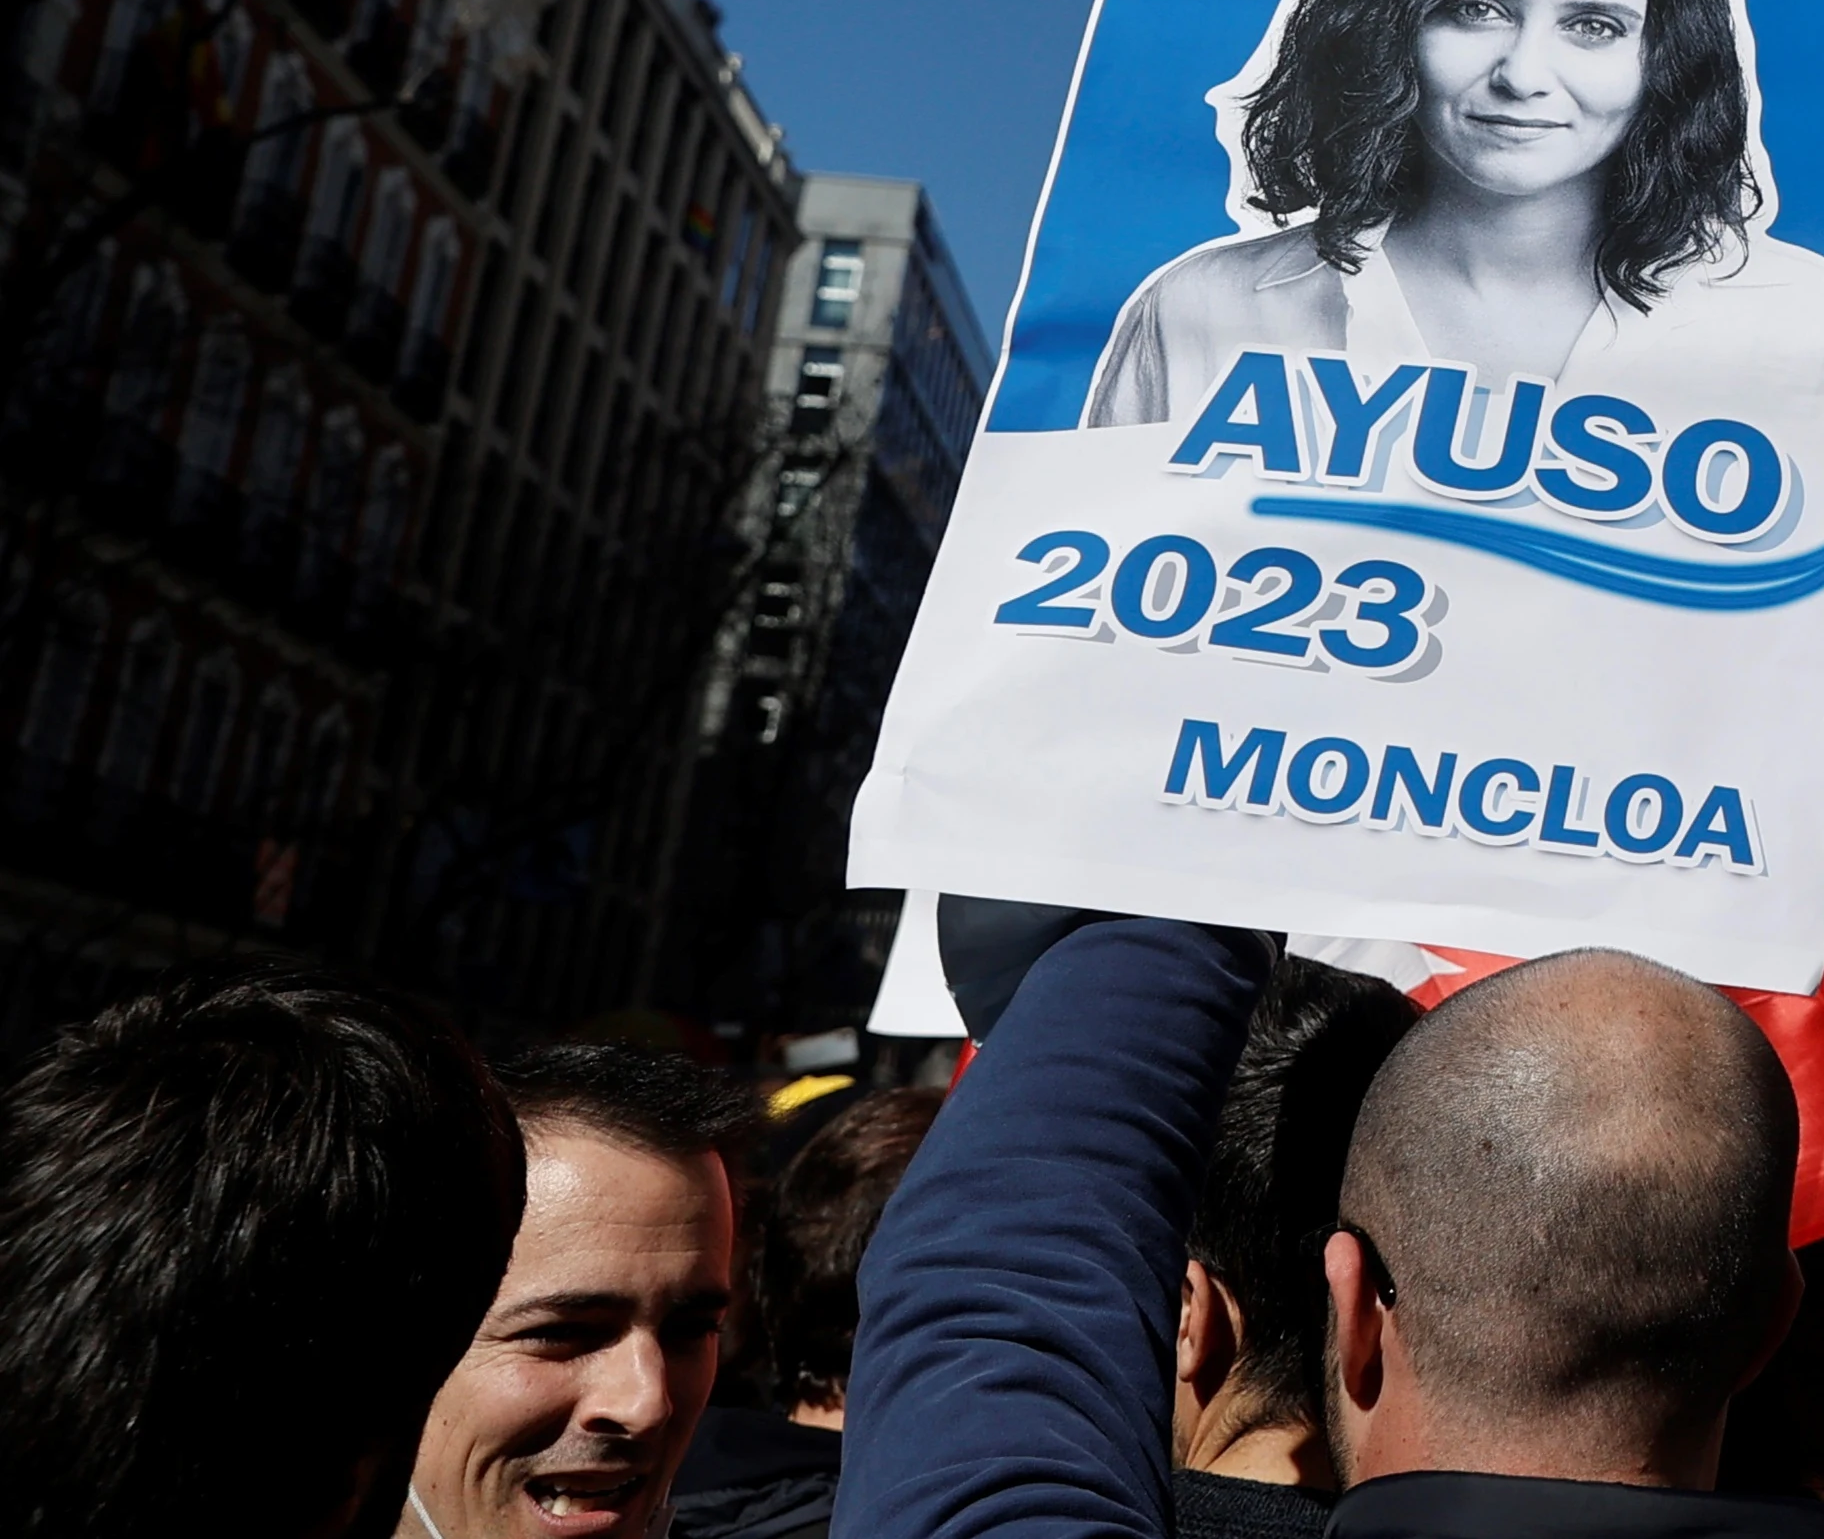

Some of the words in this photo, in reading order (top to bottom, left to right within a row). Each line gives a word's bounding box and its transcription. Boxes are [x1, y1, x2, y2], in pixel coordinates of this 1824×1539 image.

[1168, 349, 1785, 539] AYUSO
[993, 529, 1430, 669] 2023
[1163, 717, 1756, 868] MONCLOA
